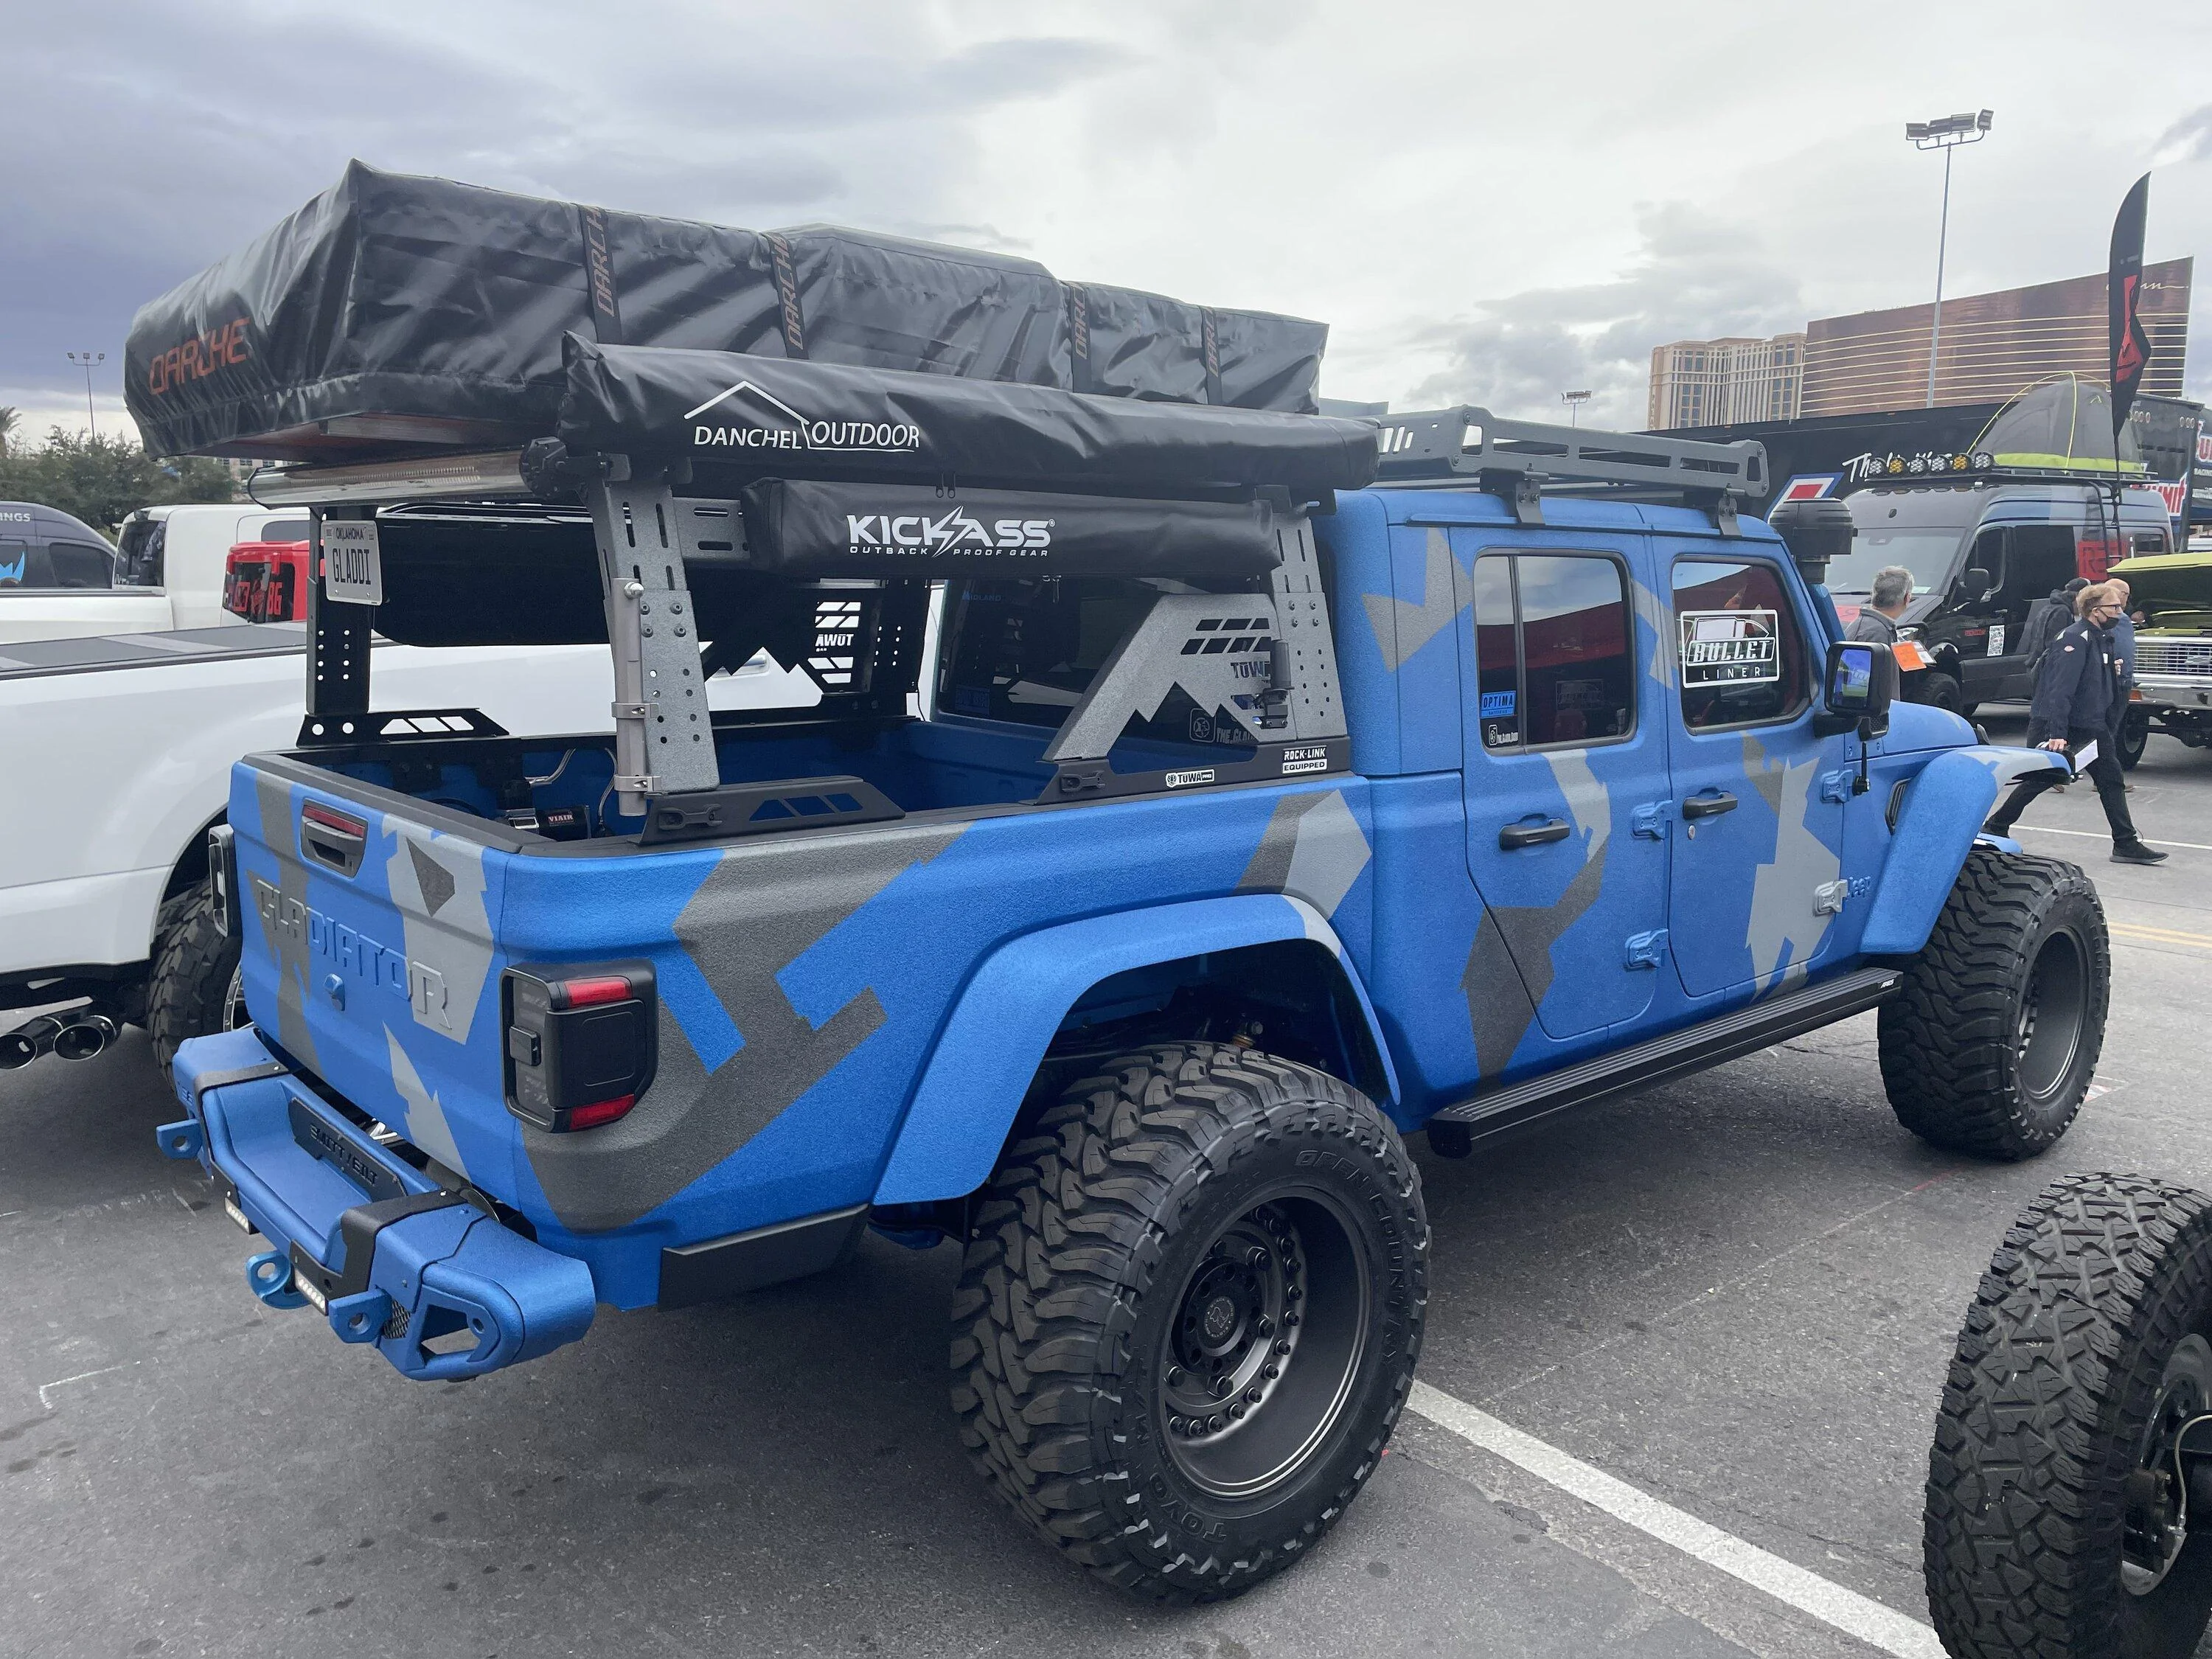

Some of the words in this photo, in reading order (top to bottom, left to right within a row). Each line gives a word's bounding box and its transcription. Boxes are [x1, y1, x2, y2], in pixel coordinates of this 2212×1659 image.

[150, 316, 251, 395] DARCHE
[694, 425, 802, 450] DANCHEL
[811, 420, 920, 448] OUTDOOR
[849, 546, 928, 555] OUTBACK
[953, 549, 1002, 557] PROOF
[1009, 549, 1048, 557] GEAR
[333, 548, 372, 585] GLADDI
[1693, 640, 1770, 663] BULLET
[1703, 666, 1761, 681] LINER
[1483, 695, 1513, 709] OPTIMA
[1284, 762, 1325, 771] EQUIPPED
[548, 813, 574, 822] VIAIR
[257, 879, 453, 1031] GLADIATOR
